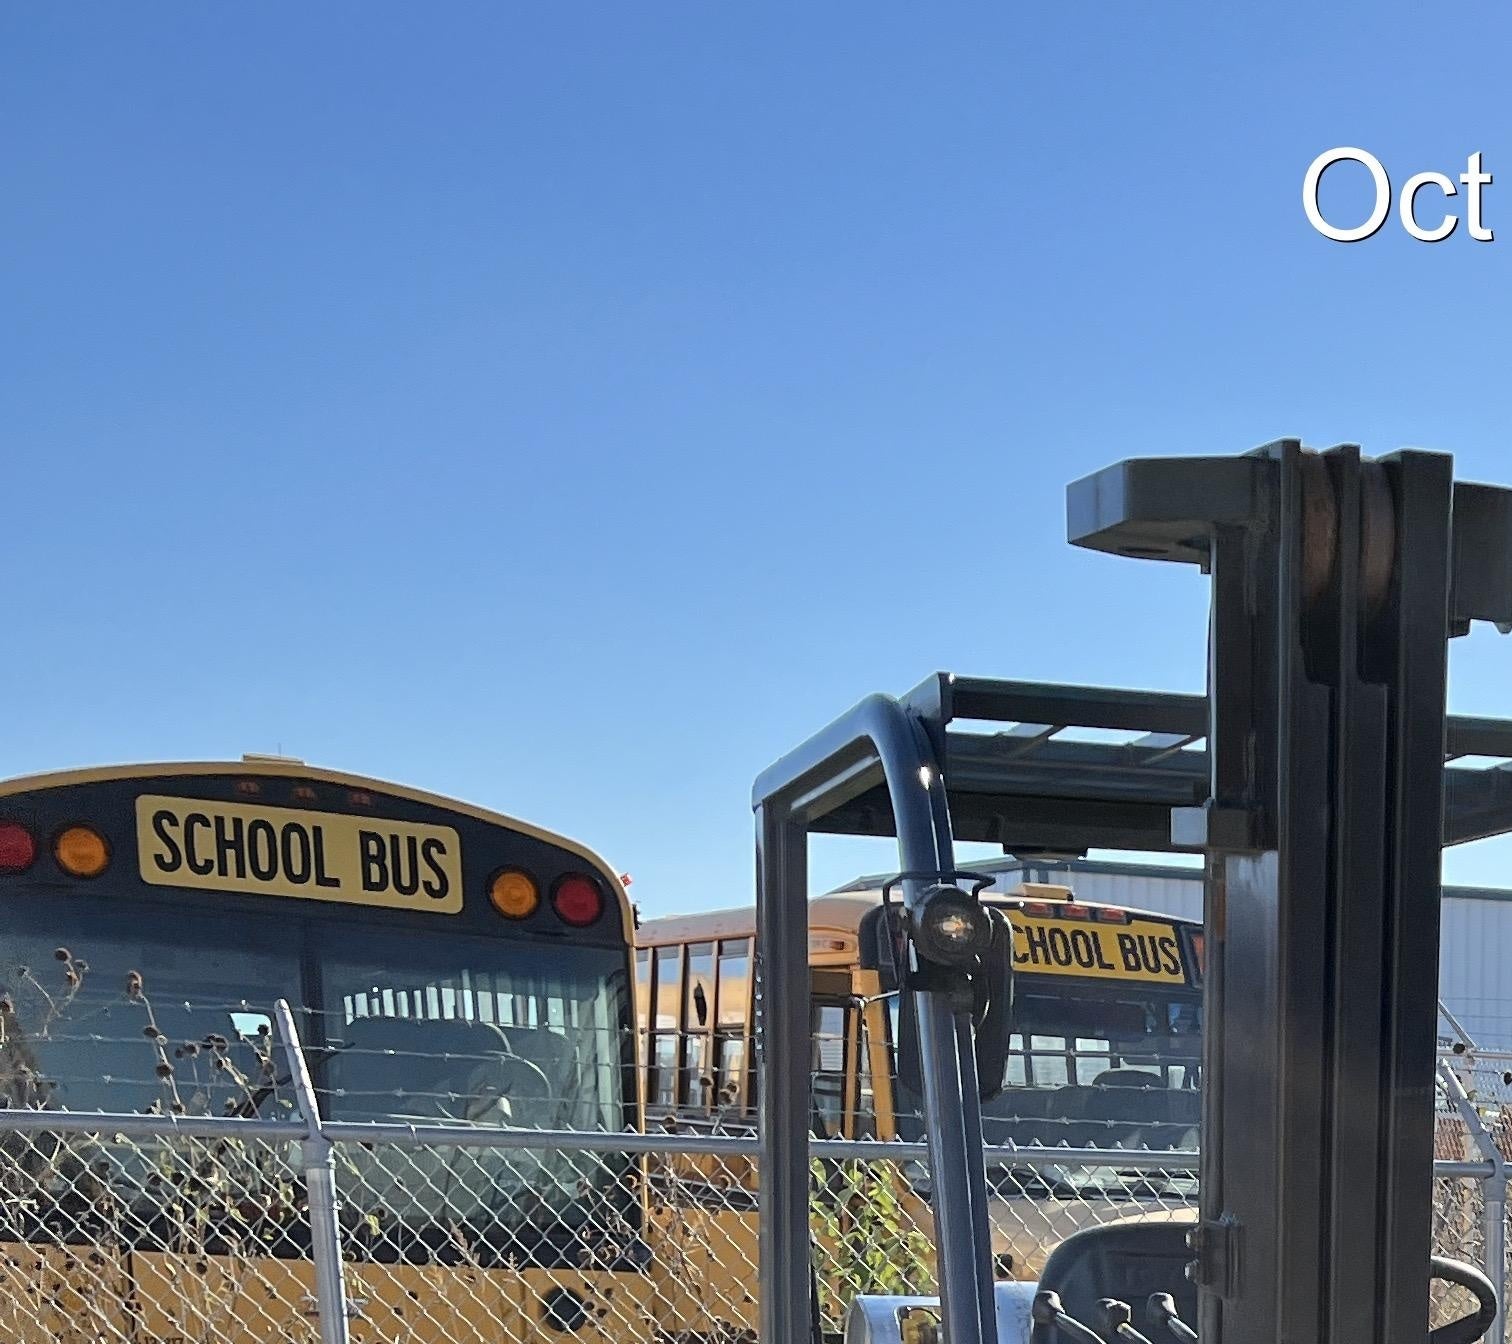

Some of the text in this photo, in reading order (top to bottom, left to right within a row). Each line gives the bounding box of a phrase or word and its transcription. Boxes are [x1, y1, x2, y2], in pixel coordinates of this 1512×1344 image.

[152, 809, 450, 899] SCHOOL BUS
[1012, 923, 1181, 975] CHOOL BUS
